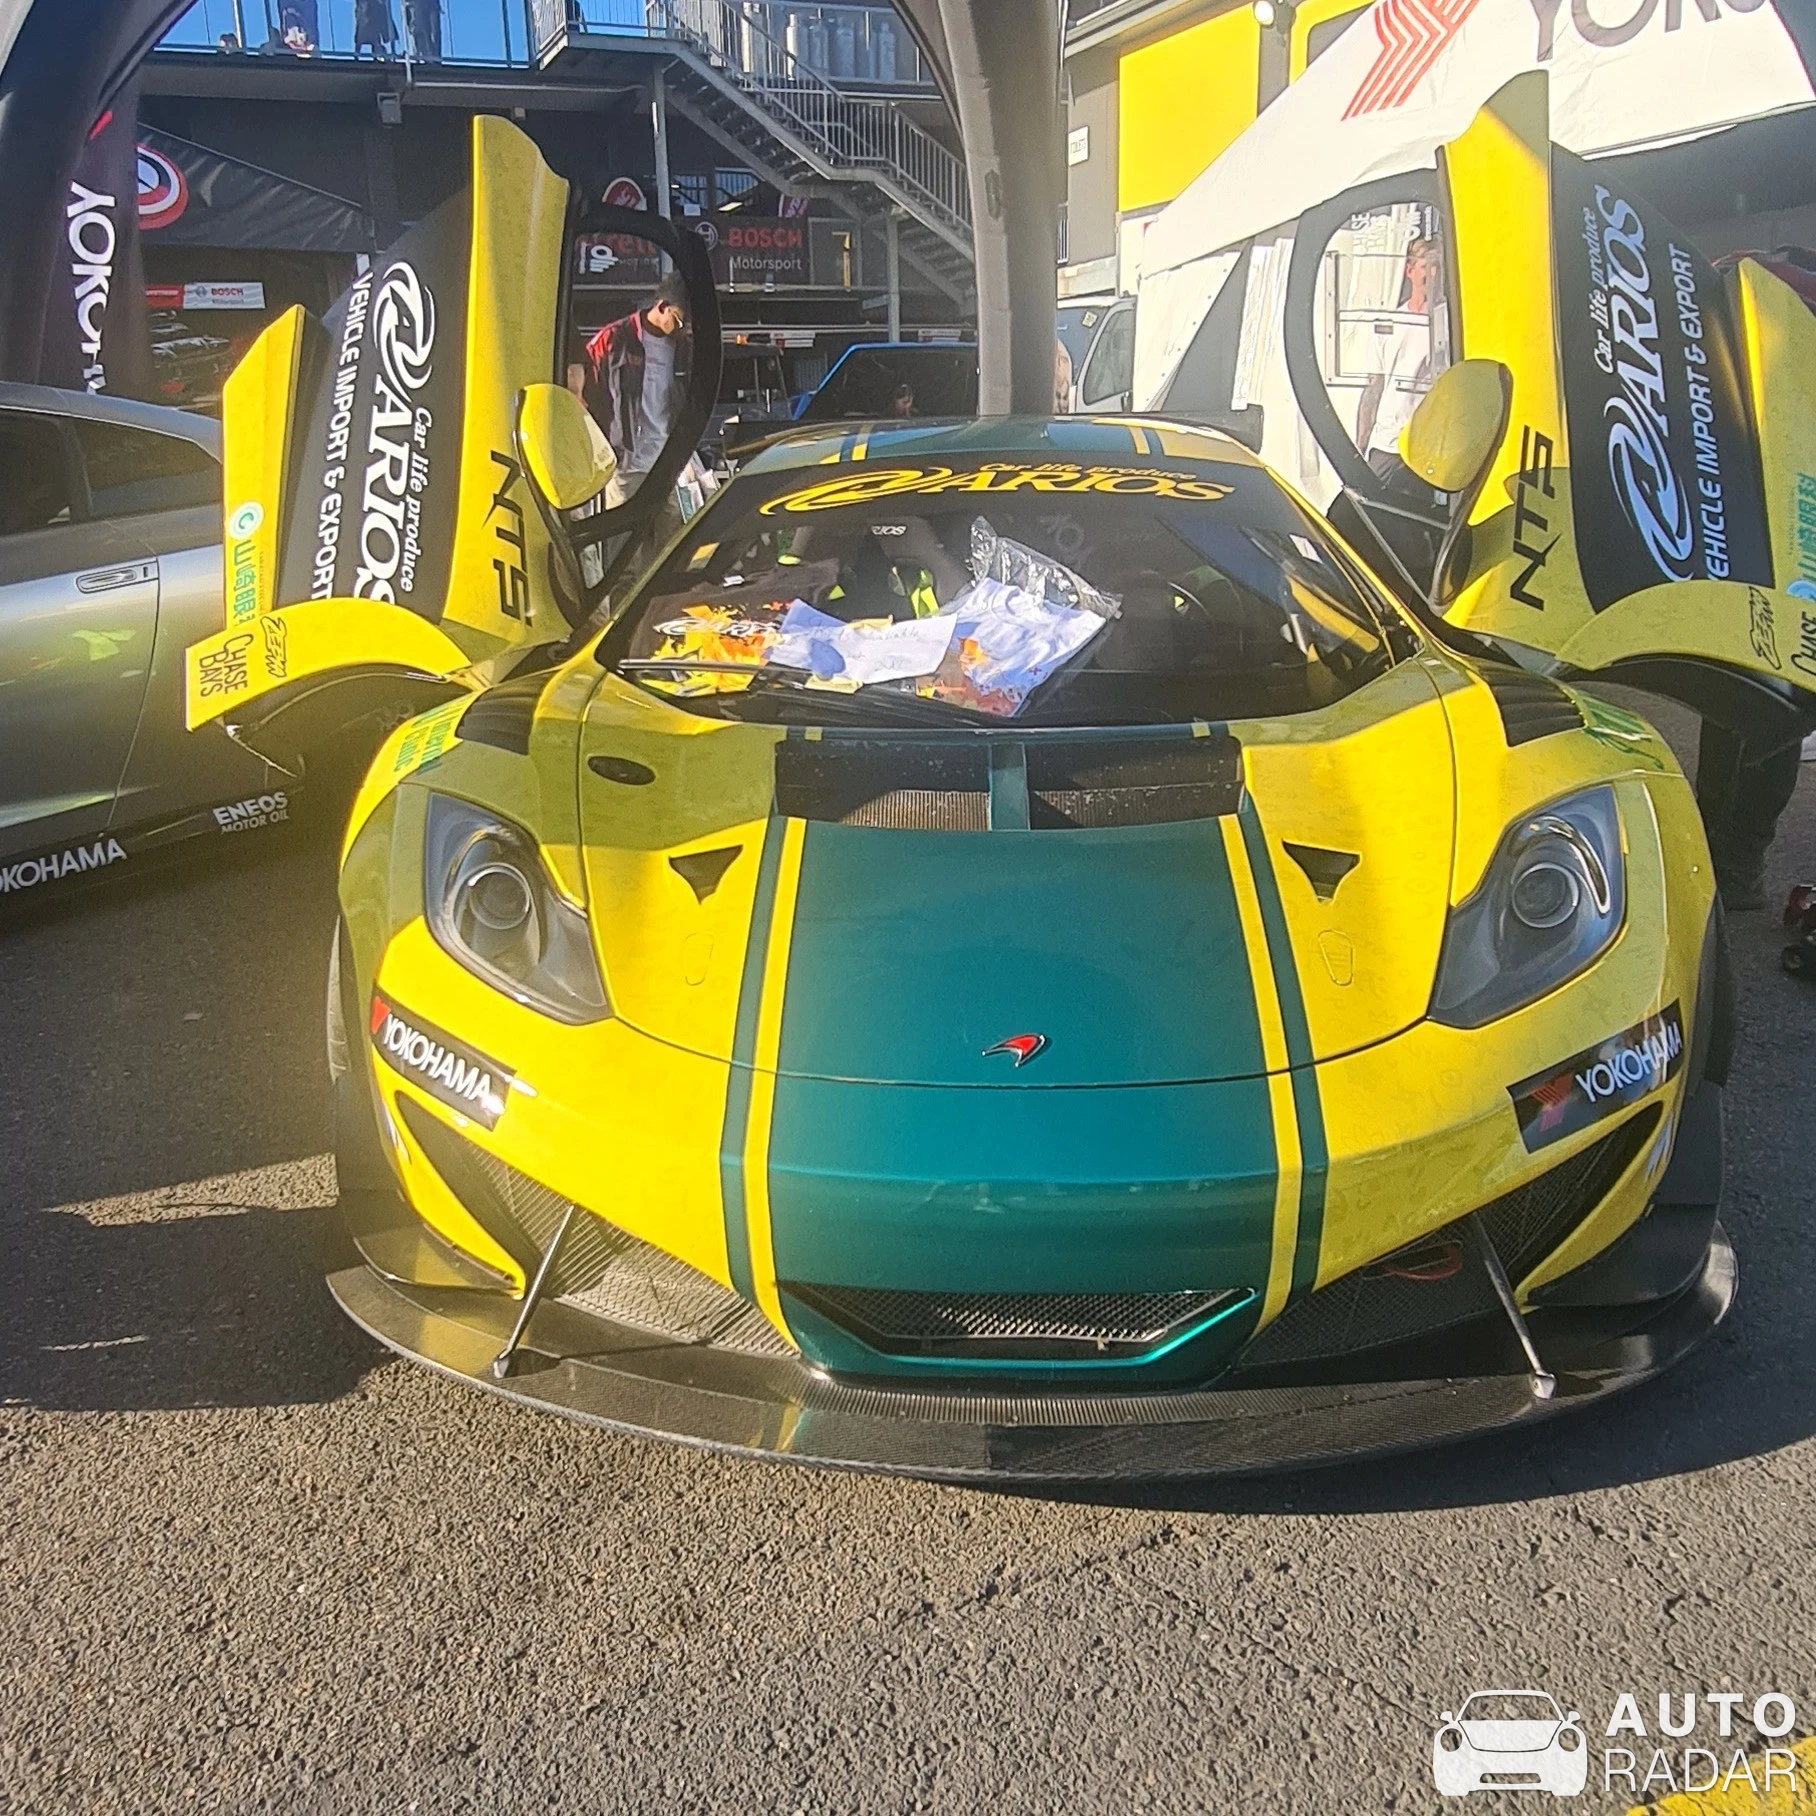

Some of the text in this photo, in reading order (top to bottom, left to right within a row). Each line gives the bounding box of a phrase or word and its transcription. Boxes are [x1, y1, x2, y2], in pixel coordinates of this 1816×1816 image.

[728, 227, 802, 249] BOSCH
[730, 256, 802, 271] Motorsport
[211, 288, 244, 296] BOSCH
[1581, 207, 1614, 374] Car life produce
[312, 272, 374, 600] VEHICLE IMPORT & EXPORT
[1668, 242, 1731, 581] EHICLE IMPORT & EXPORT
[980, 463, 1031, 471] Car
[1085, 466, 1197, 480] produce
[401, 407, 433, 592] Car life produce
[199, 653, 224, 698] BAYS
[223, 633, 254, 695] CHASE
[213, 792, 288, 825] ENEOS
[221, 809, 289, 835] MOTOR OIL
[383, 1013, 497, 1102] YOKOHAMA
[1575, 1021, 1683, 1103] YOKOHAMA
